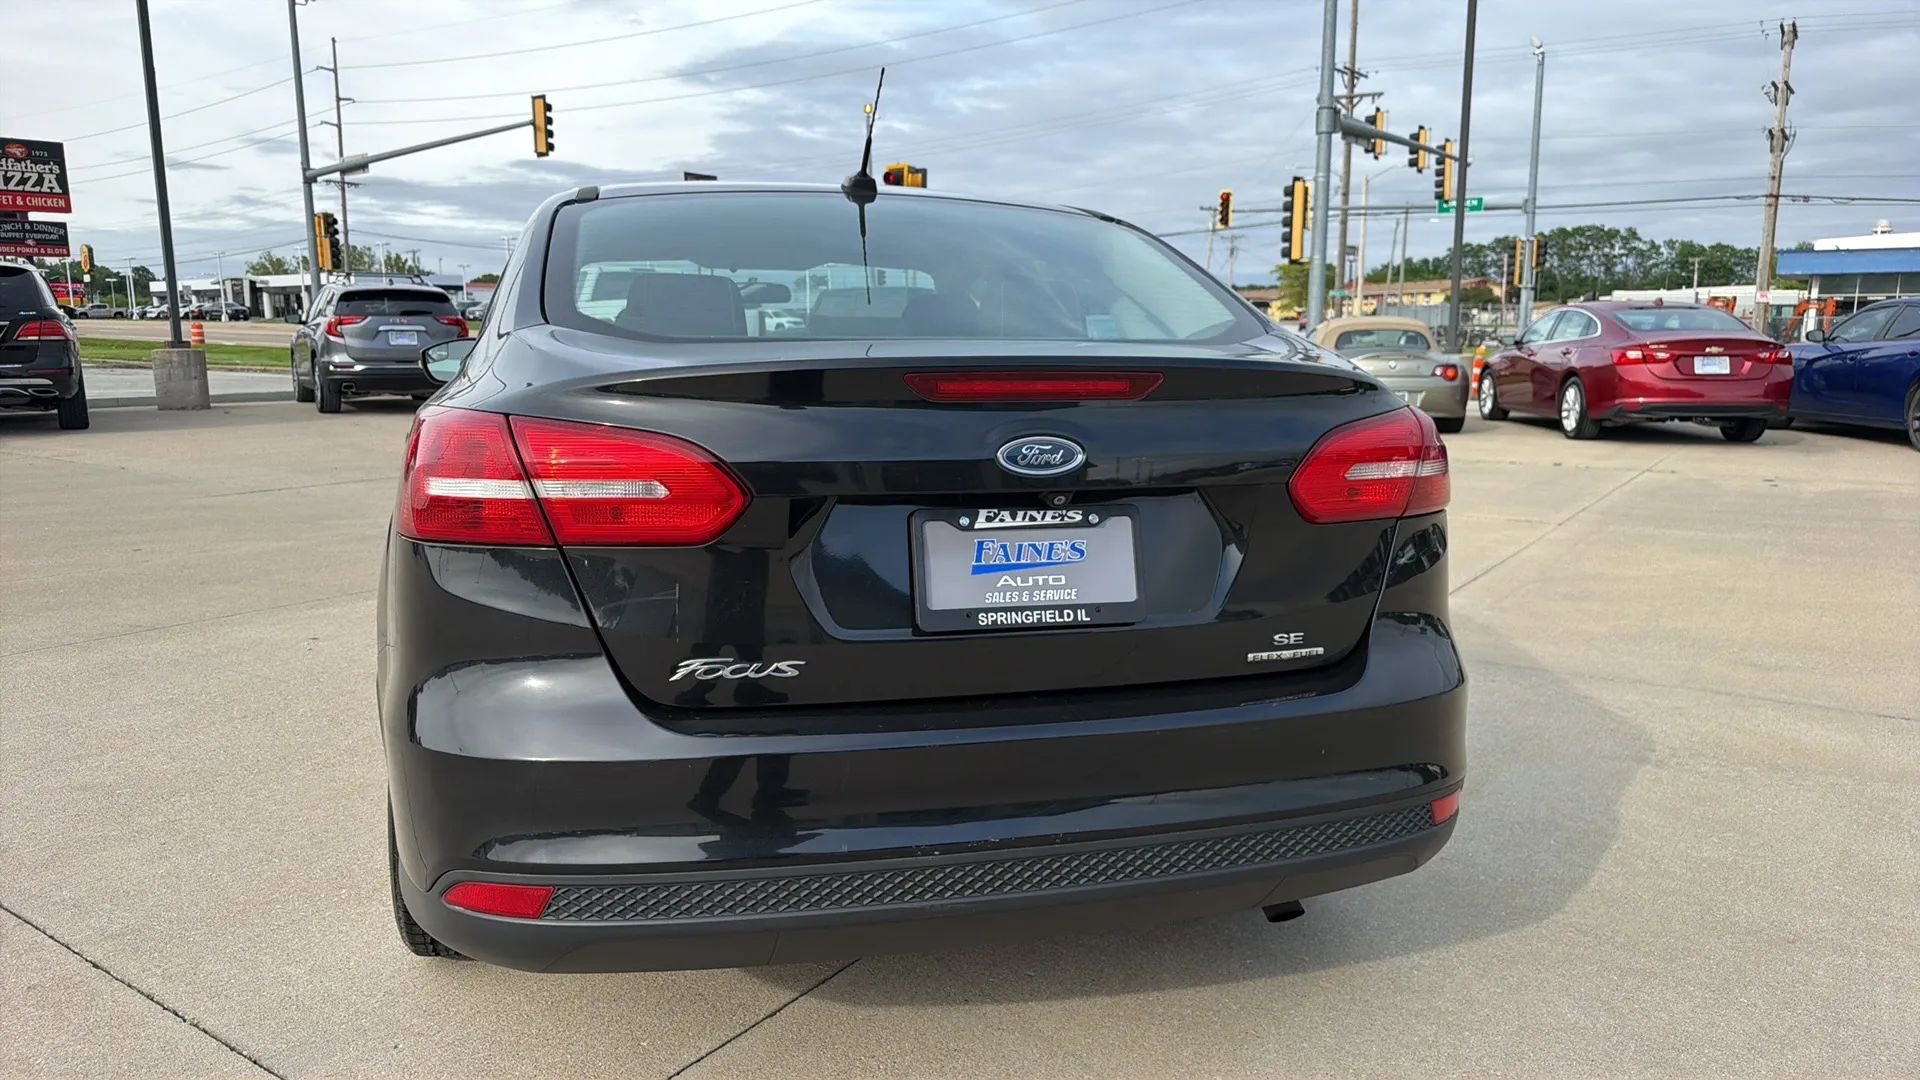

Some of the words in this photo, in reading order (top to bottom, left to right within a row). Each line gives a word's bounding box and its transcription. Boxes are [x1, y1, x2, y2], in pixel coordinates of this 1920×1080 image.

[0, 195, 13, 205] ET
[16, 195, 24, 206] &
[26, 196, 65, 208] CHICKEN
[24, 222, 31, 230] &
[33, 223, 65, 236] DINNER
[47, 247, 67, 255] SLOTS
[1017, 443, 1064, 466] Ford
[975, 508, 1083, 524] FAINE'S
[972, 538, 1087, 565] FAINE'S
[996, 575, 1066, 587] AUTO
[985, 592, 1019, 604] SALES
[1022, 591, 1030, 602] &
[1033, 588, 1078, 601] SERVICE
[978, 609, 1074, 626] SPRINGFIELD
[1077, 609, 1091, 622] IL
[1272, 632, 1305, 646] SE
